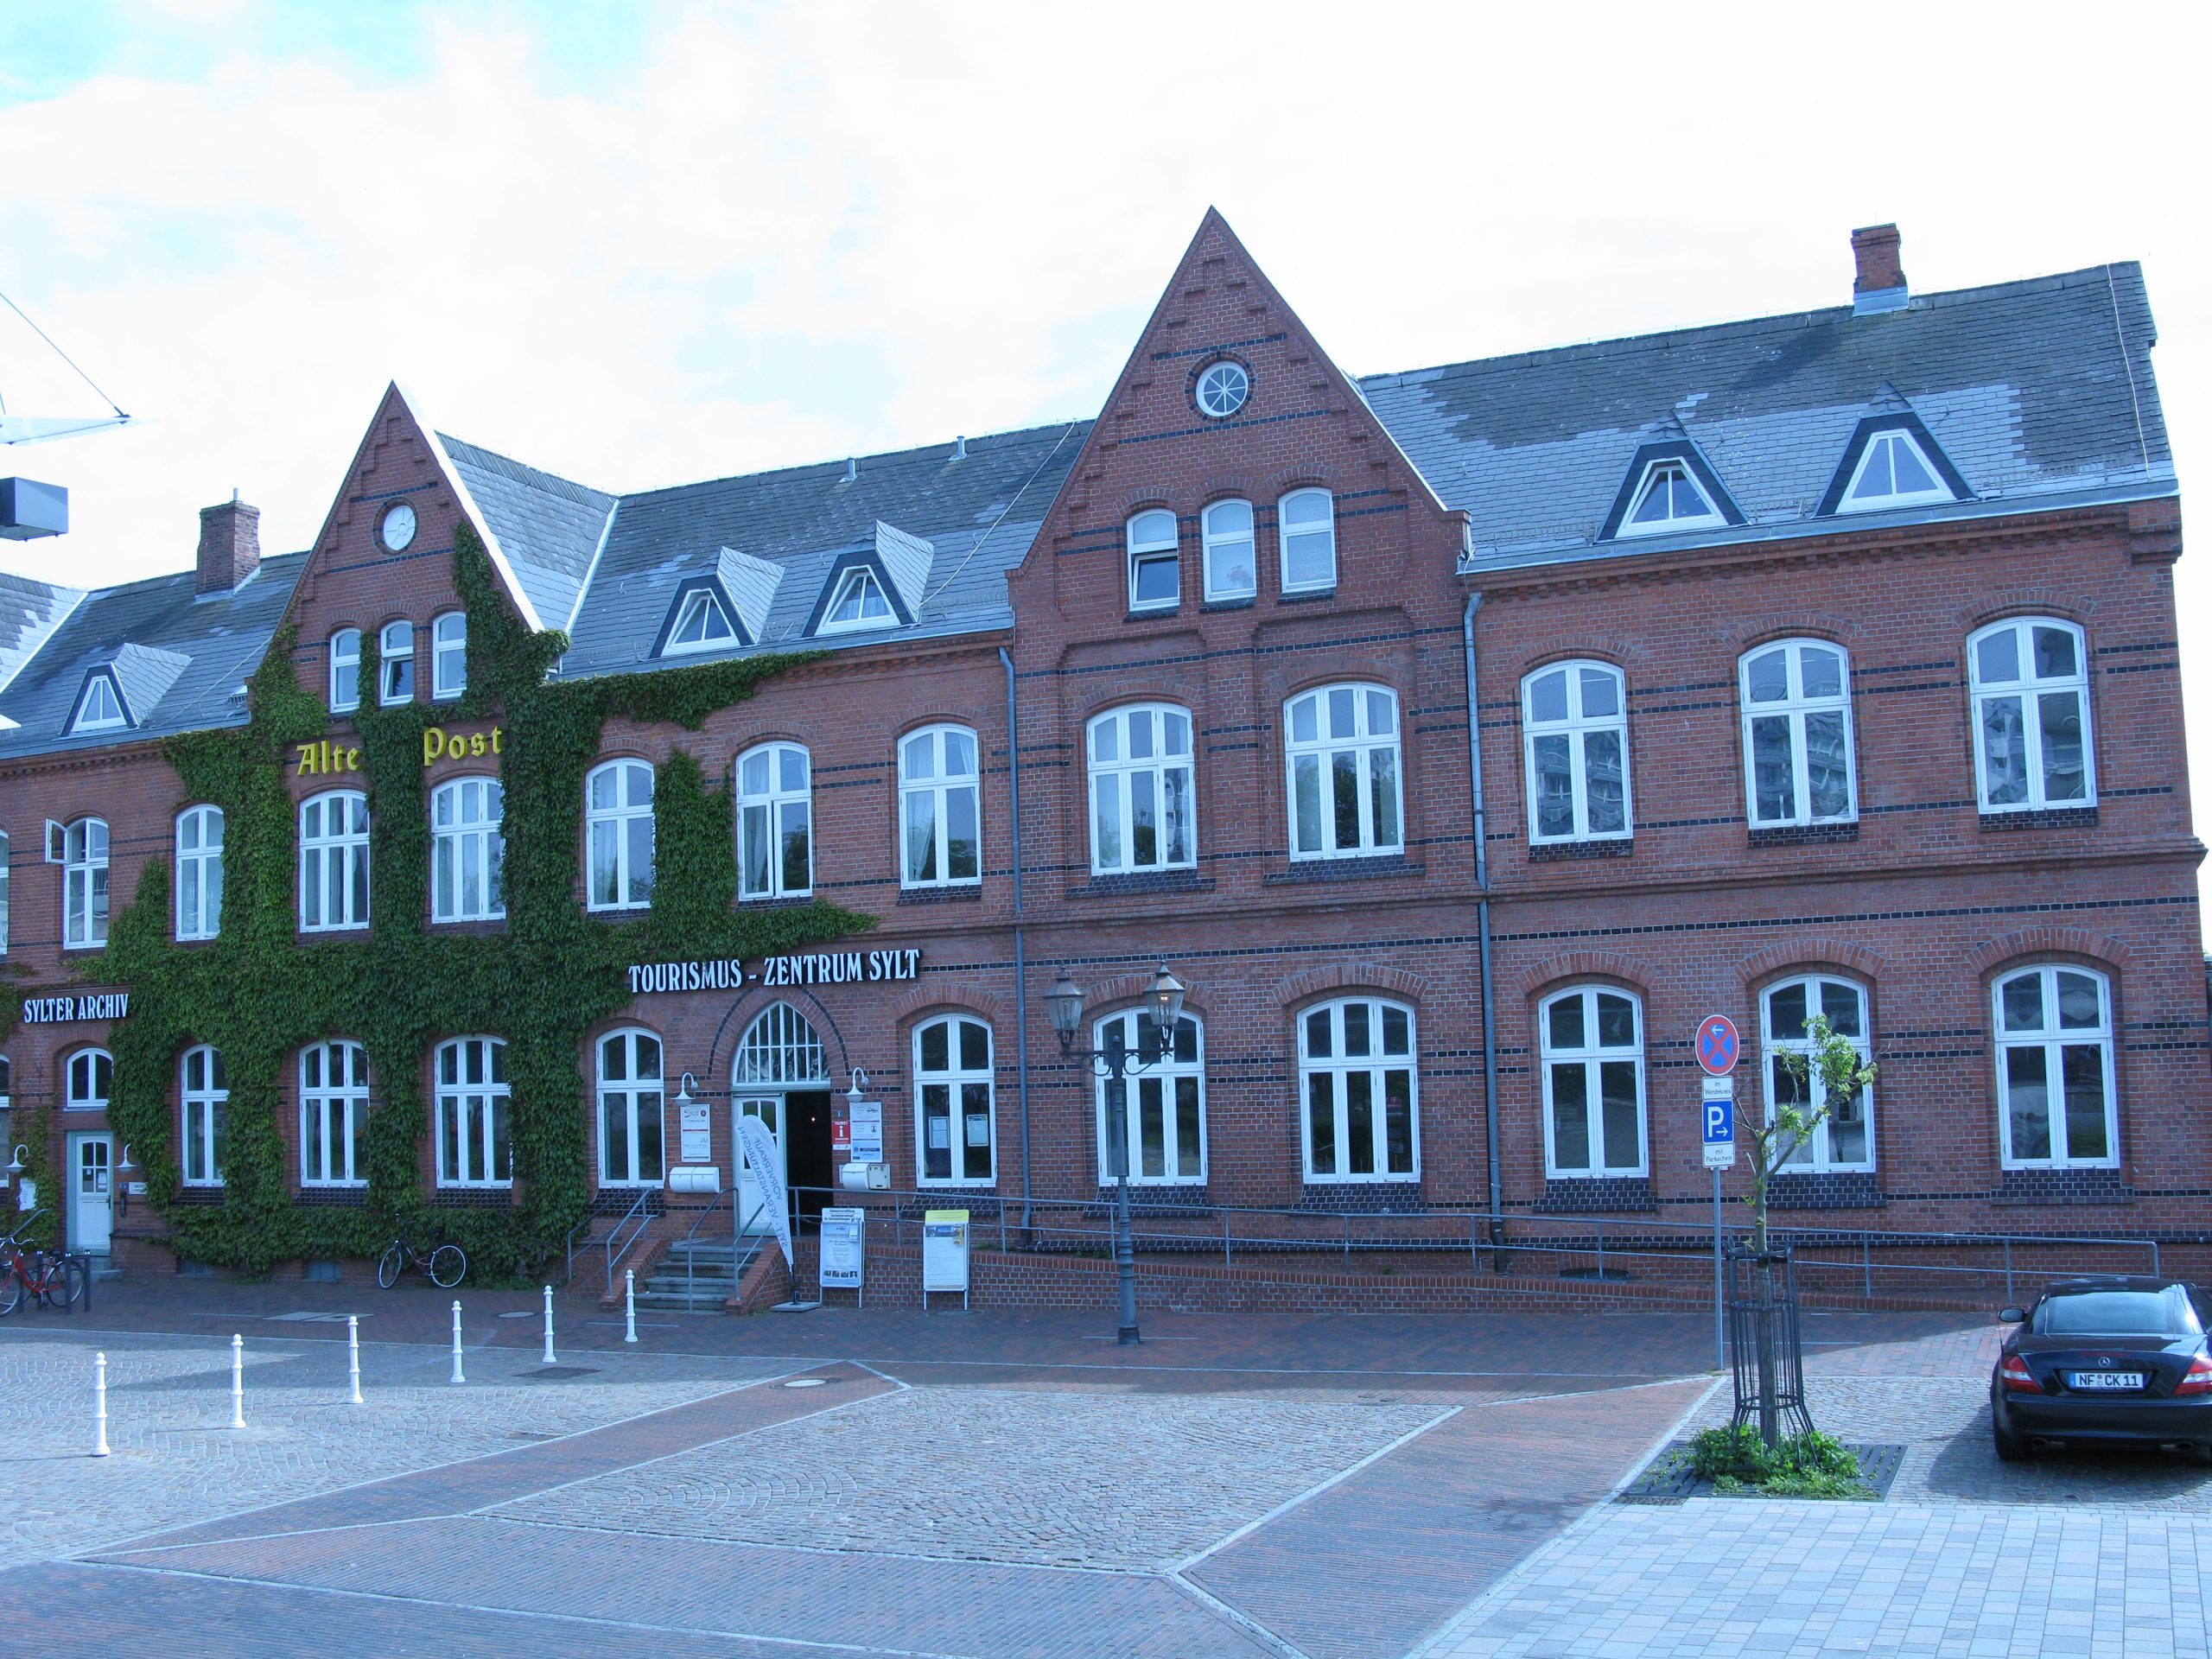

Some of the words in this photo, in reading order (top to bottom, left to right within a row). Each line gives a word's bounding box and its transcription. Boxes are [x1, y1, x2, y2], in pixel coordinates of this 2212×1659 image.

[296, 740, 360, 776] Alte
[423, 725, 502, 766] Post
[628, 959, 742, 993] TOURISMUS
[764, 952, 863, 986] ZENTRUM
[868, 949, 919, 981] SYLT
[24, 996, 74, 1023] SYLTER
[78, 994, 129, 1020] ARCHIV
[1707, 1106, 1724, 1138] P
[2079, 1375, 2094, 1386] NF
[2105, 1375, 2120, 1386] CK
[2123, 1375, 2139, 1386] 11
